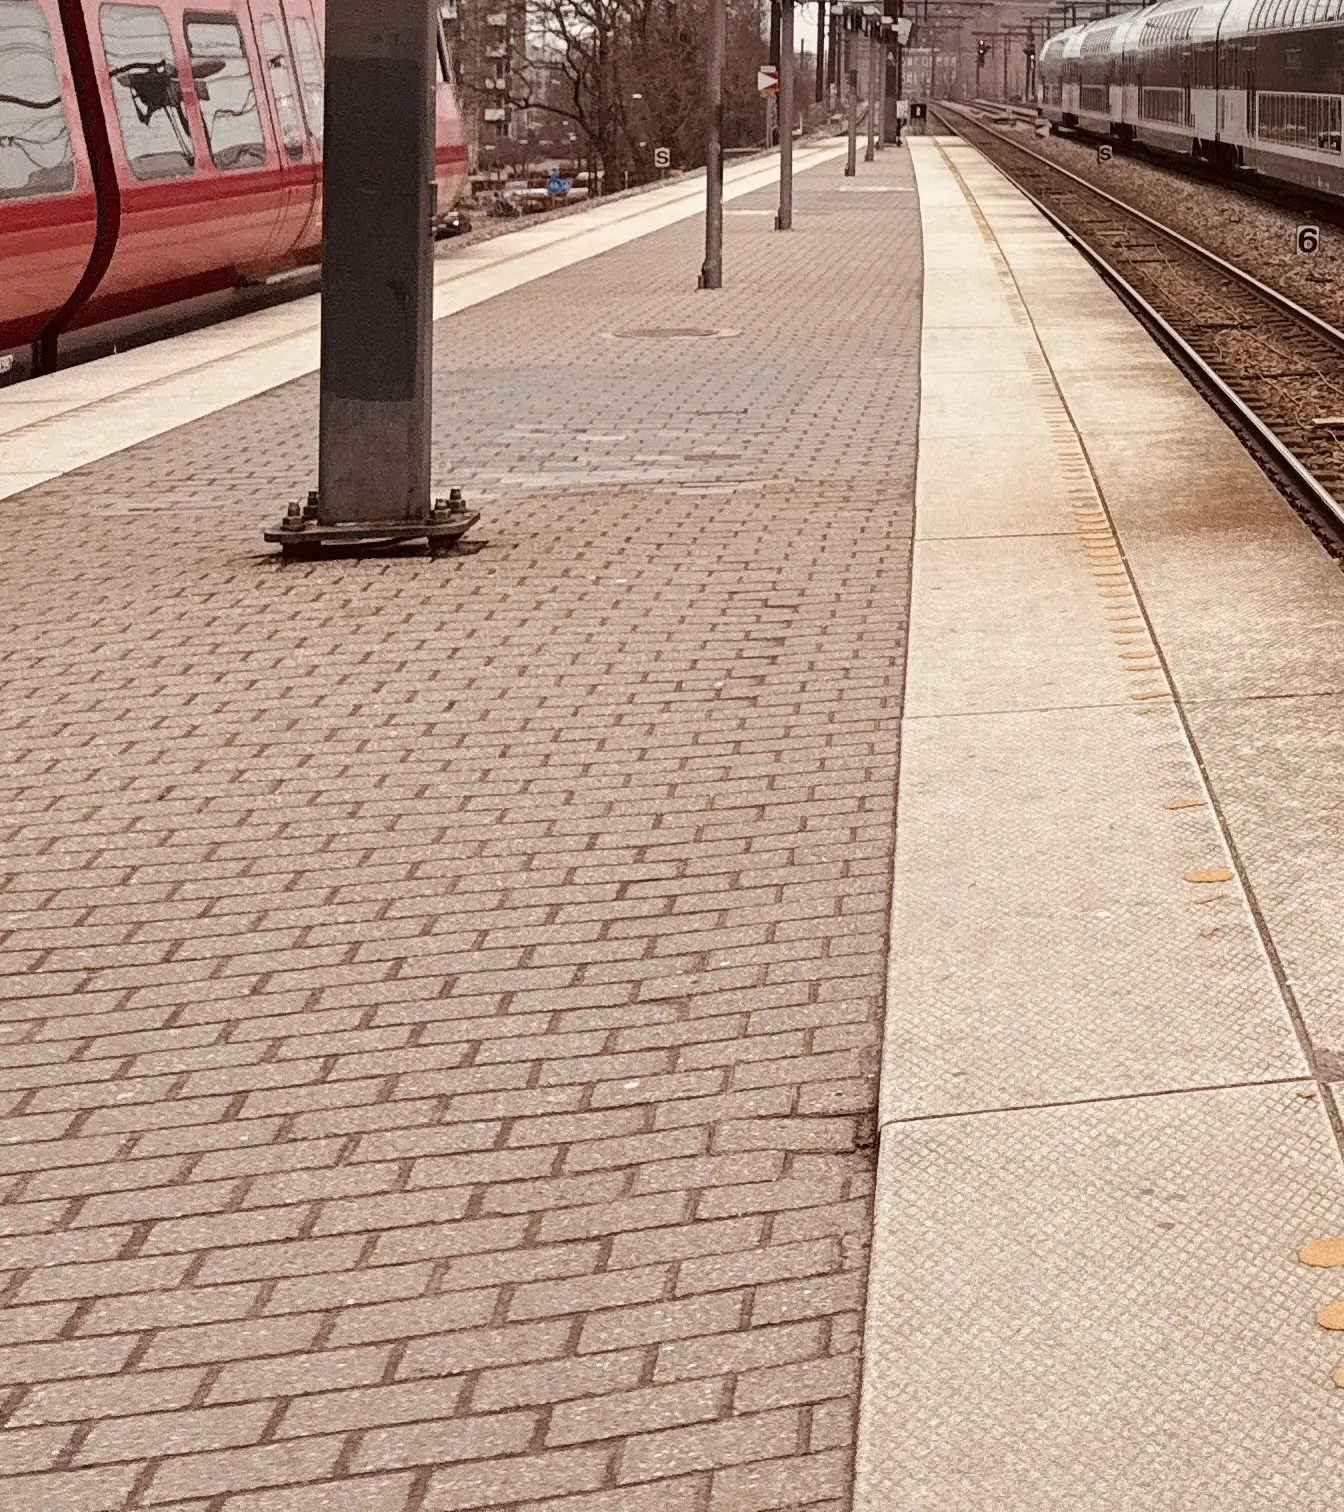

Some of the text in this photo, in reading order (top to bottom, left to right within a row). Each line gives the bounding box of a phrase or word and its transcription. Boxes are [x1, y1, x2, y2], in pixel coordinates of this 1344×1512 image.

[656, 150, 669, 165] S
[1100, 148, 1112, 161] S
[1298, 228, 1318, 253] 6
